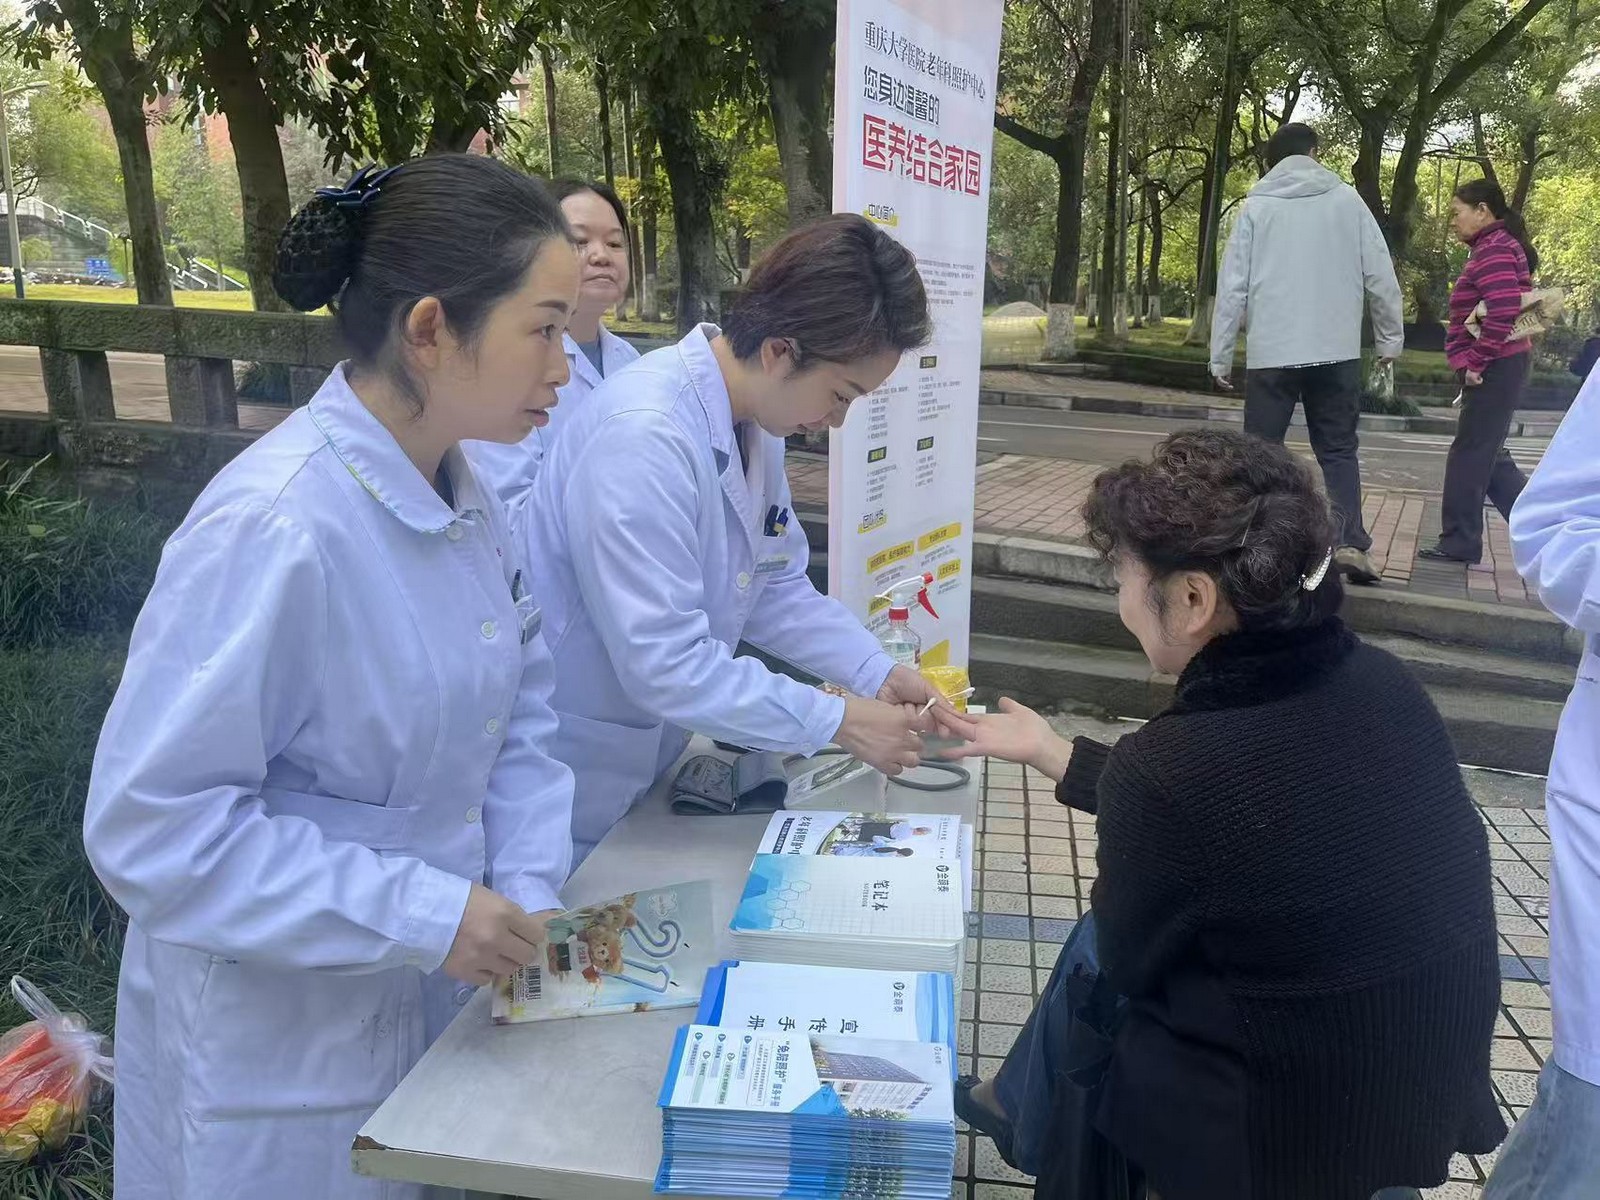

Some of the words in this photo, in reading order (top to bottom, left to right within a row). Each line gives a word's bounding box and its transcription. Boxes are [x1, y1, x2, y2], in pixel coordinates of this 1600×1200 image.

[864, 21, 986, 99] 重庆大学医院老年科照护中心
[863, 65, 940, 125] 您身边温馨的
[862, 113, 982, 196] 医养结合家园
[871, 879, 890, 911] 笔记本
[747, 1014, 859, 1034] 宣传手册
